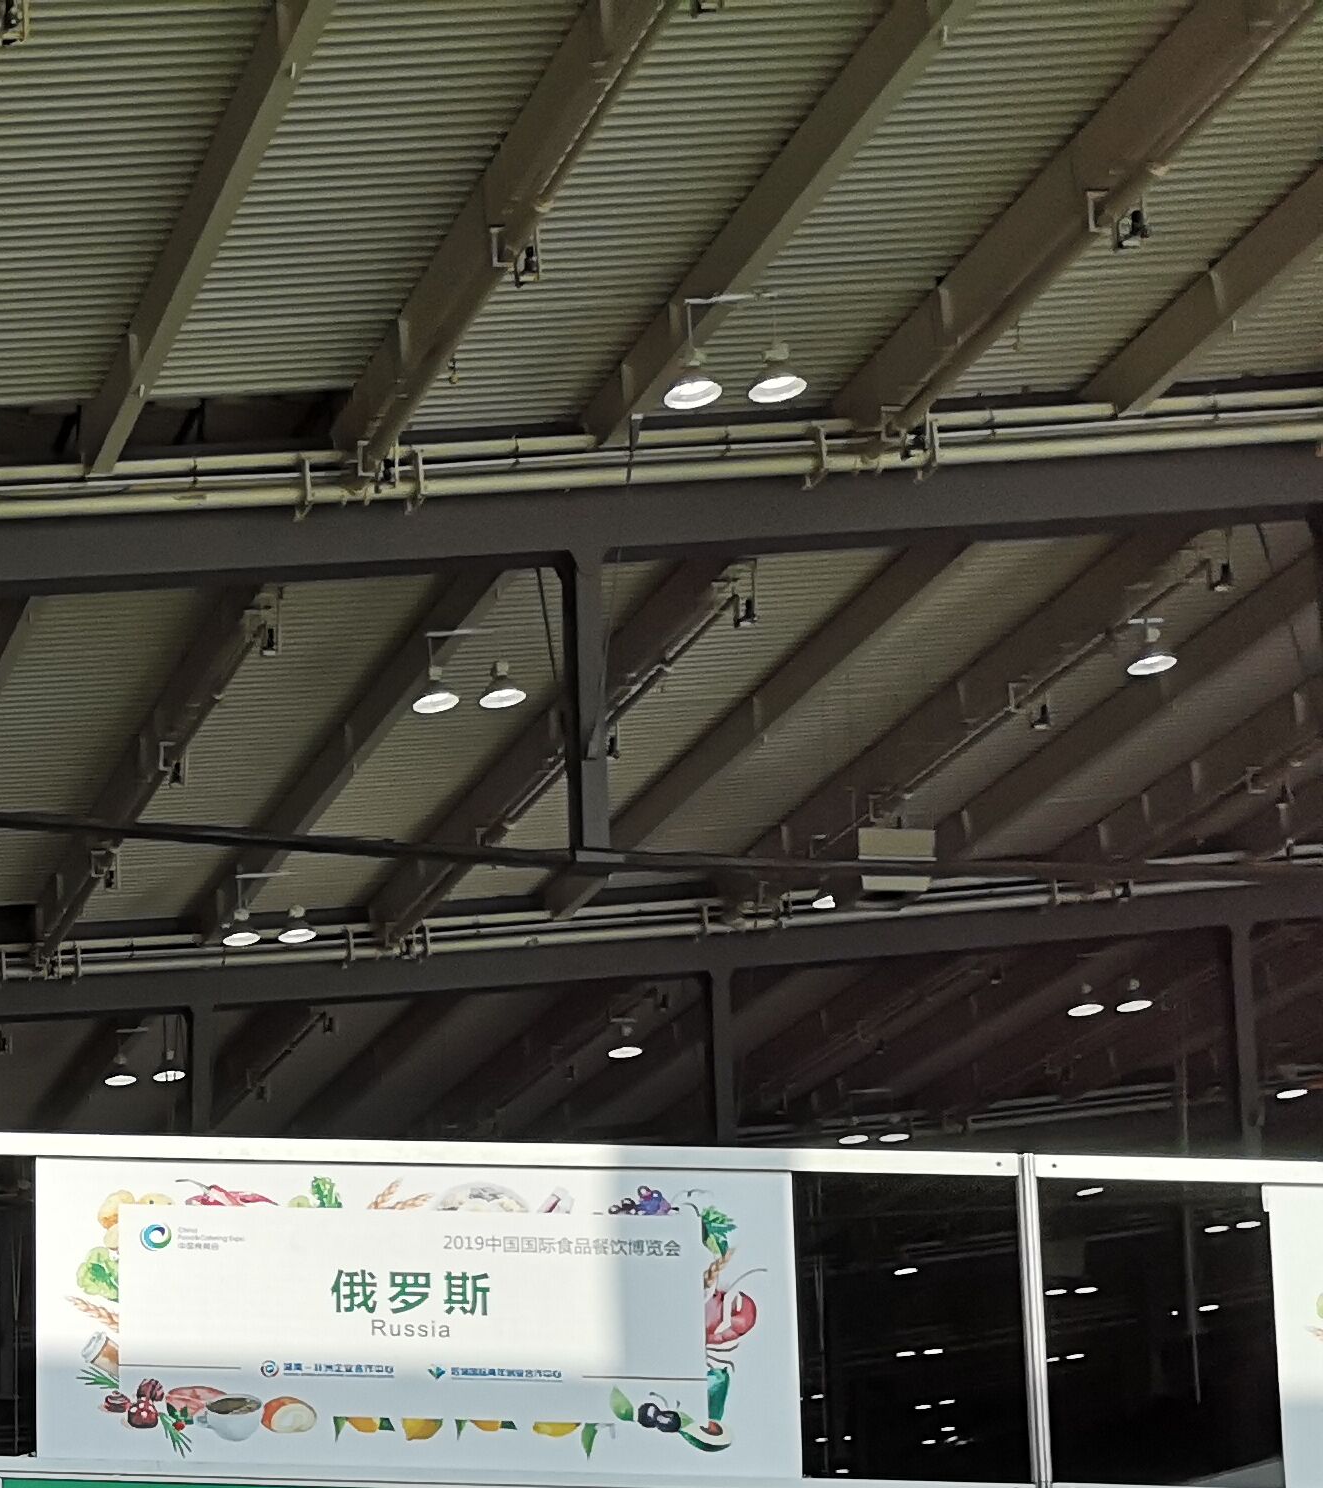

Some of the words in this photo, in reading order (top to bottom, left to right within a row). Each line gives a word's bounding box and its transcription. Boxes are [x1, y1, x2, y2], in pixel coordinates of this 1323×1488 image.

[443, 1235, 681, 1257] 2019中国国际食品餐饮博览会
[331, 1269, 490, 1316] 俄罗斯
[371, 1319, 451, 1338] Russia
